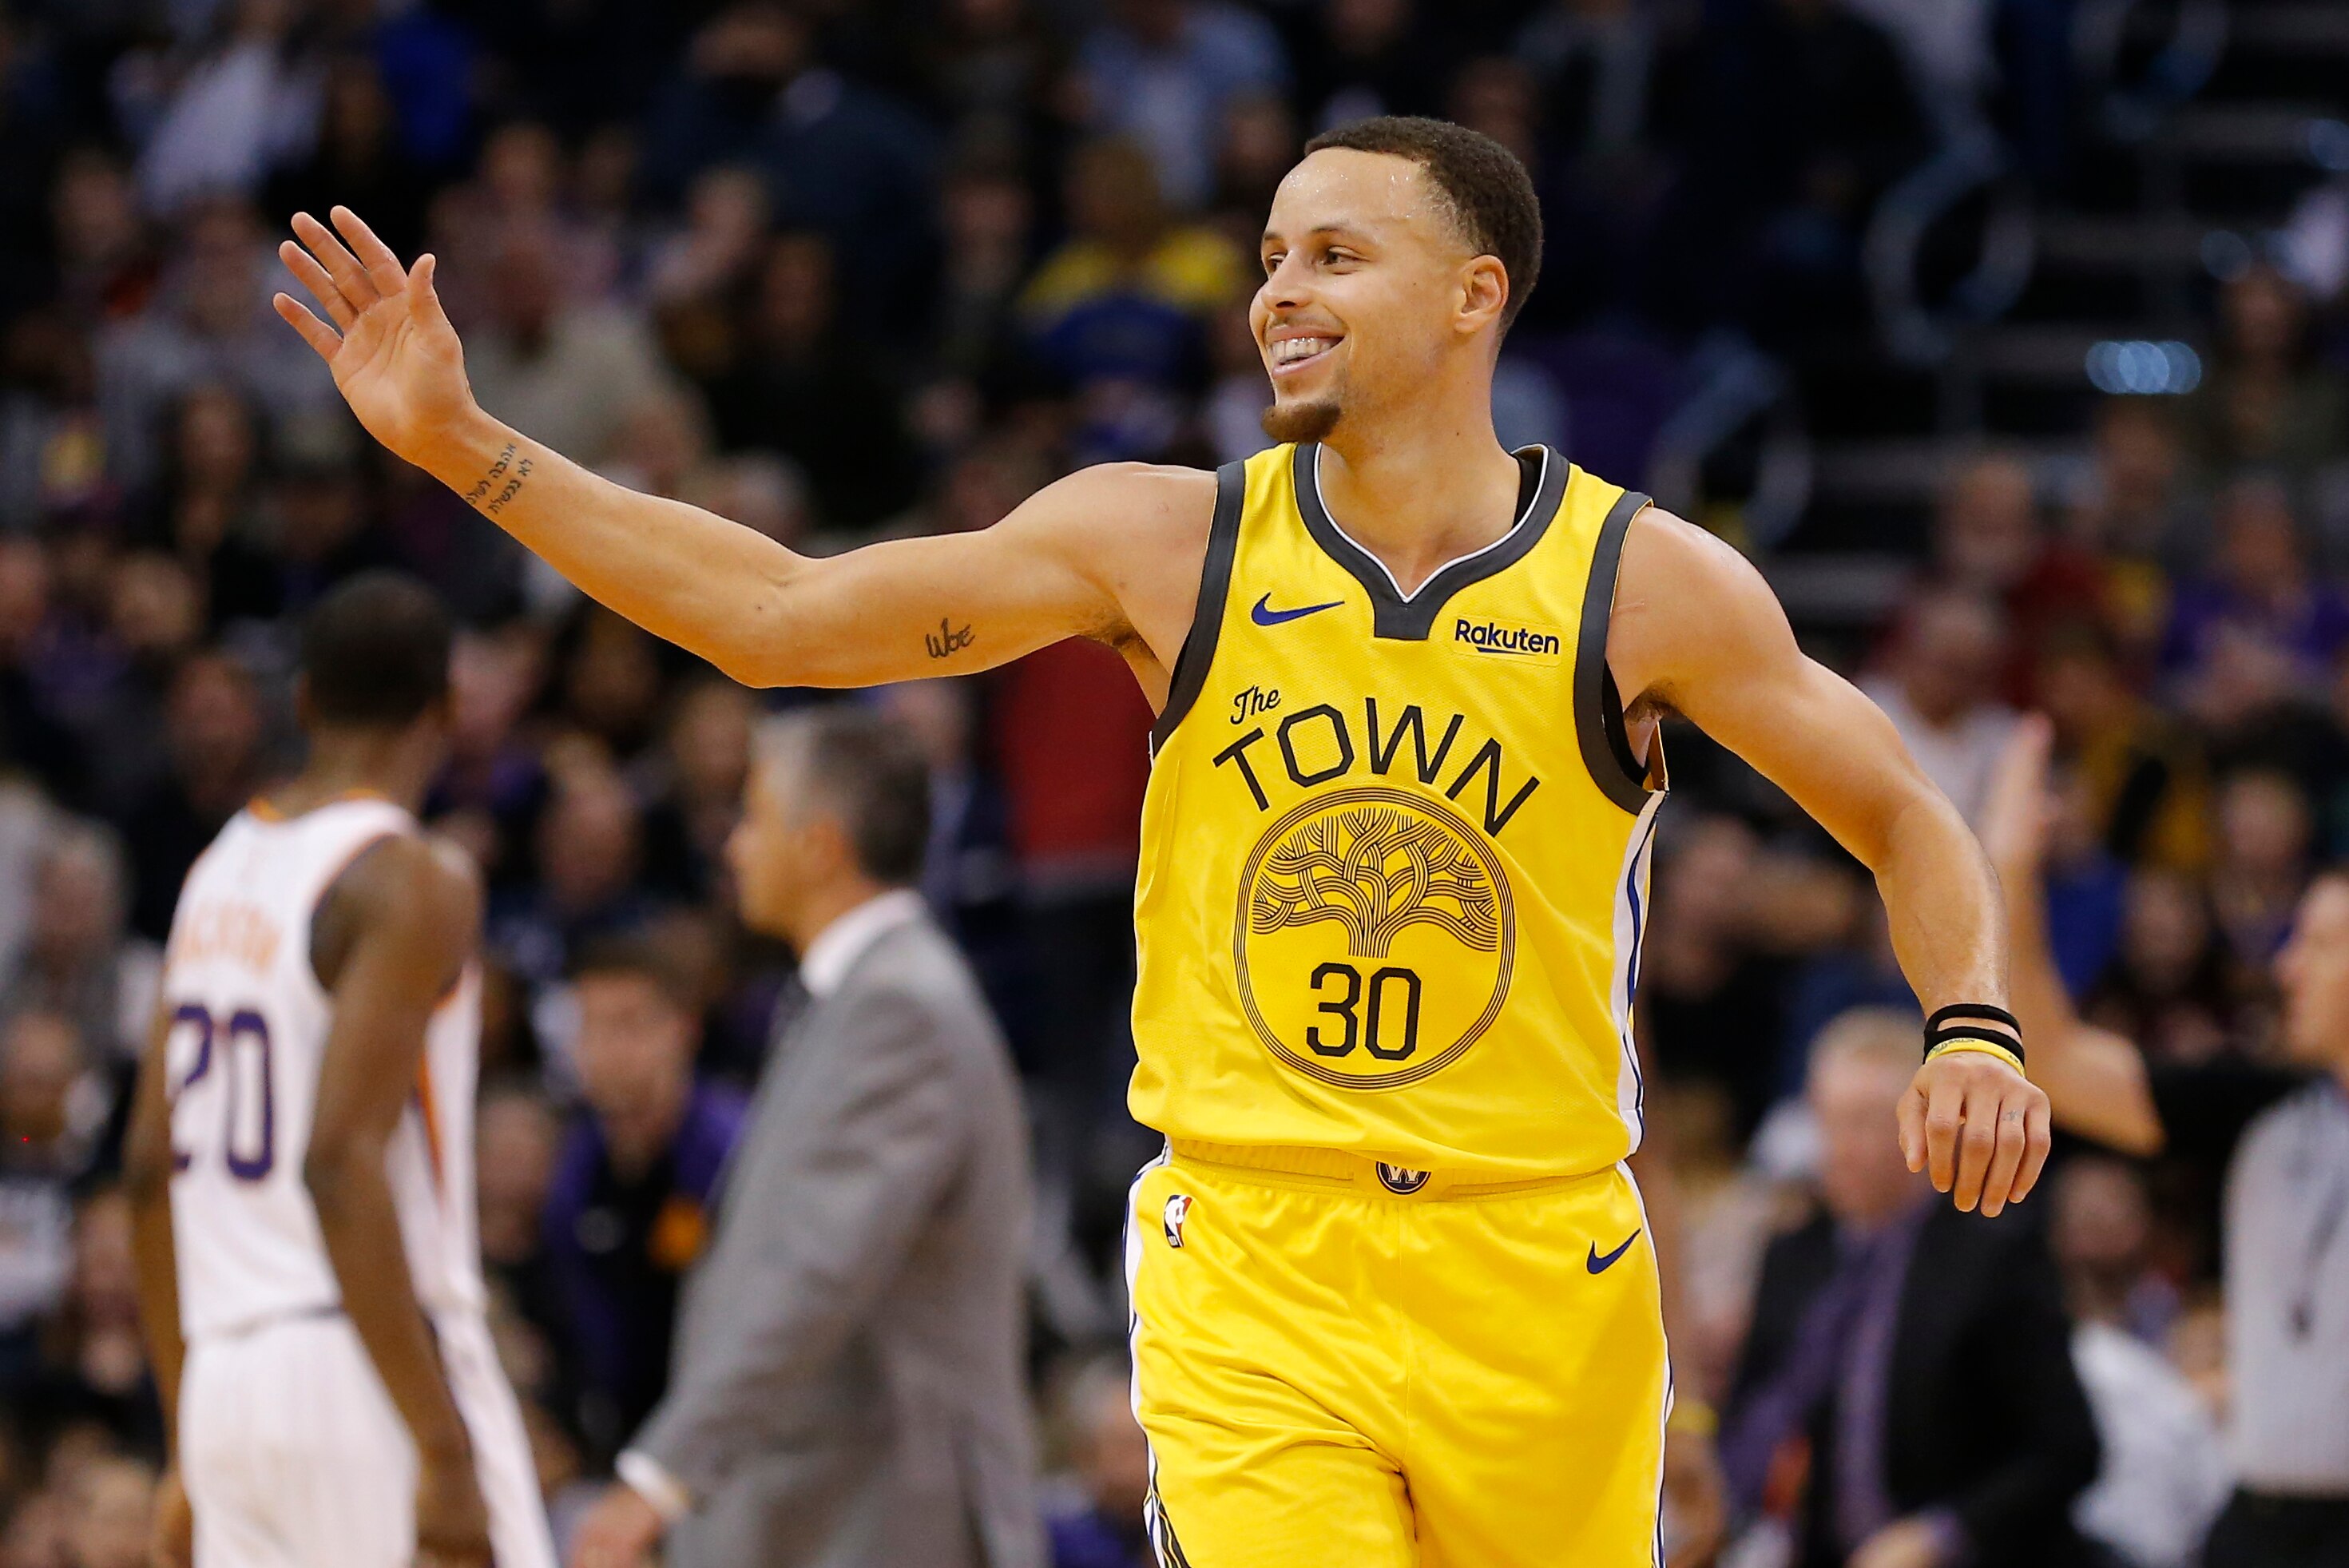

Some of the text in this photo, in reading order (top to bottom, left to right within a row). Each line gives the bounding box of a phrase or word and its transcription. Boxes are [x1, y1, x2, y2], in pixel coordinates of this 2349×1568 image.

[517, 458, 534, 478] לא
[1454, 618, 1561, 655] Rakuten
[1230, 685, 1282, 725] The
[1212, 697, 1541, 837] TOWN
[1306, 962, 1422, 1061] 30
[169, 1002, 275, 1181] 20
